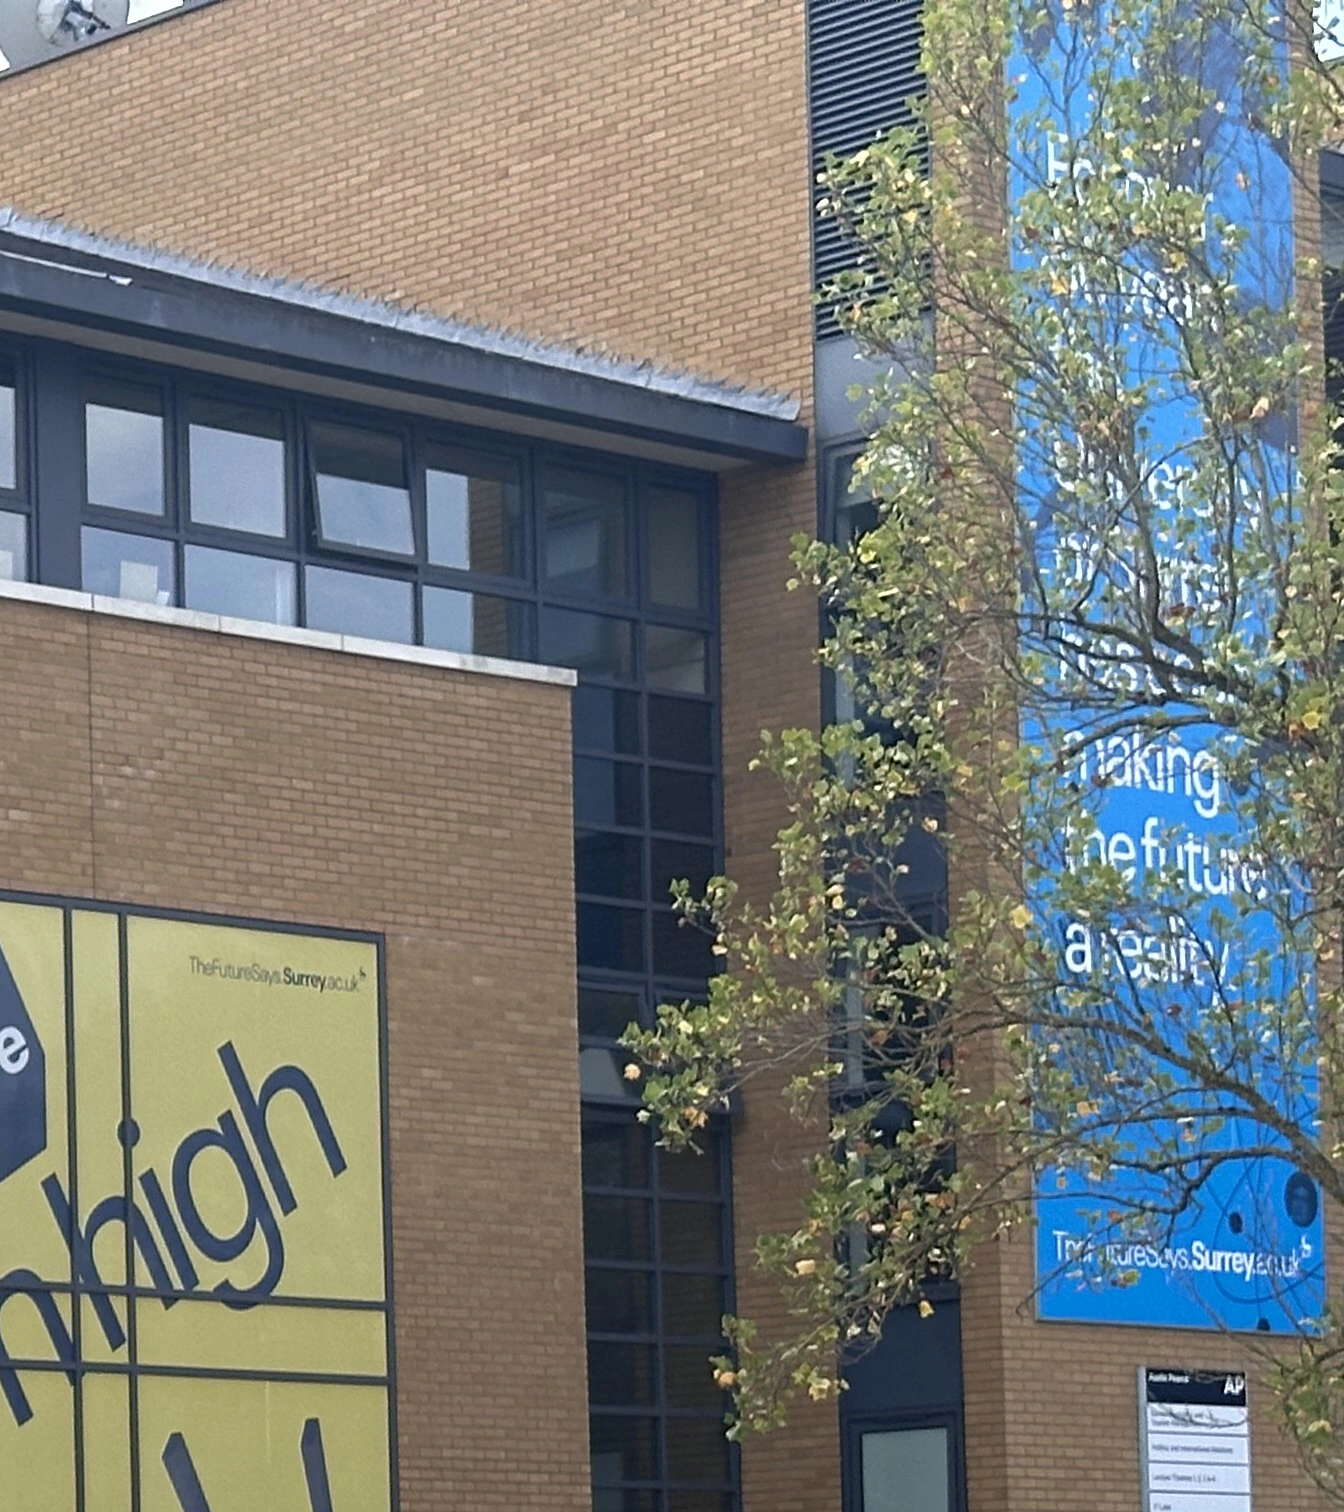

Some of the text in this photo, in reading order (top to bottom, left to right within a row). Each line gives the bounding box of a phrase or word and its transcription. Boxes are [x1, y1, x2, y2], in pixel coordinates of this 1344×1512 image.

[1065, 922, 1092, 973] a
[188, 955, 359, 992] TheFutureSays.Surrey.ac.uk
[41, 1040, 348, 1352] high
[1223, 1375, 1245, 1395] AP
